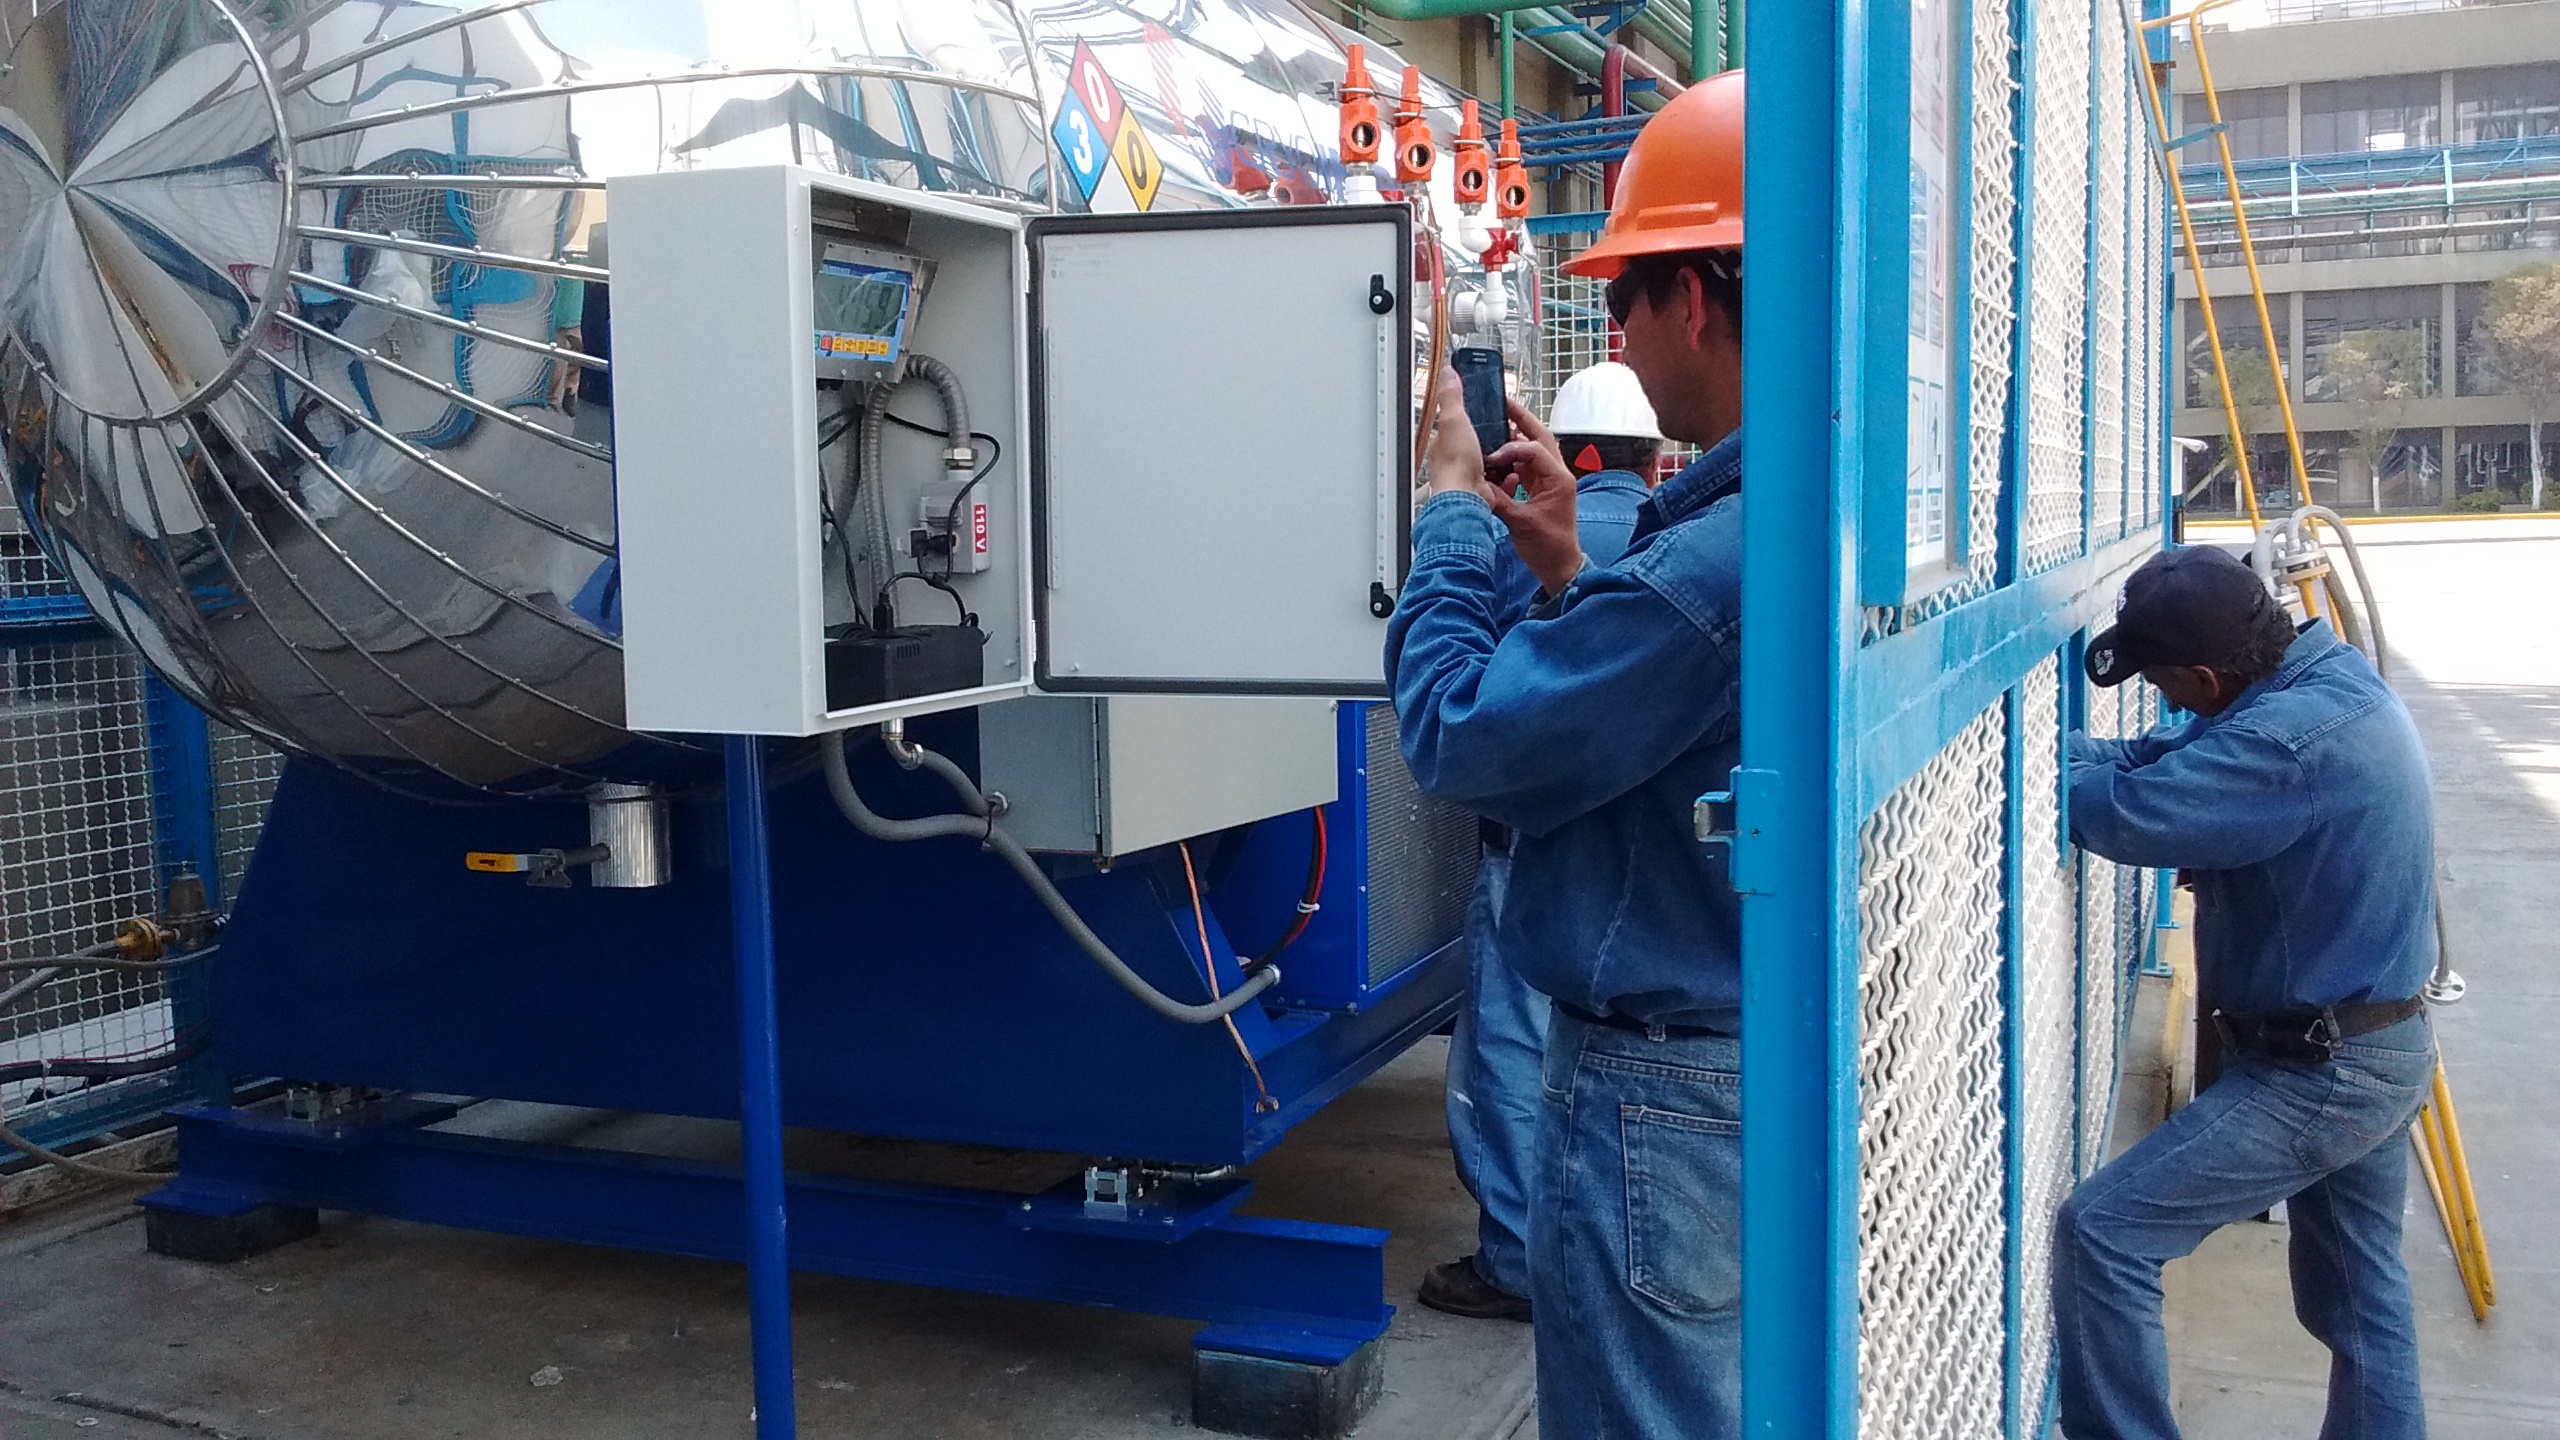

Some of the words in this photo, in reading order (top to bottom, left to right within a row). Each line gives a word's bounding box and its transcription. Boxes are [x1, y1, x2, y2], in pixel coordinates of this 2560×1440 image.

[1083, 60, 1111, 123] 0
[1069, 108, 1094, 175] 3
[1126, 130, 1147, 190] 0
[975, 507, 985, 534] 110
[976, 537, 986, 550] V
